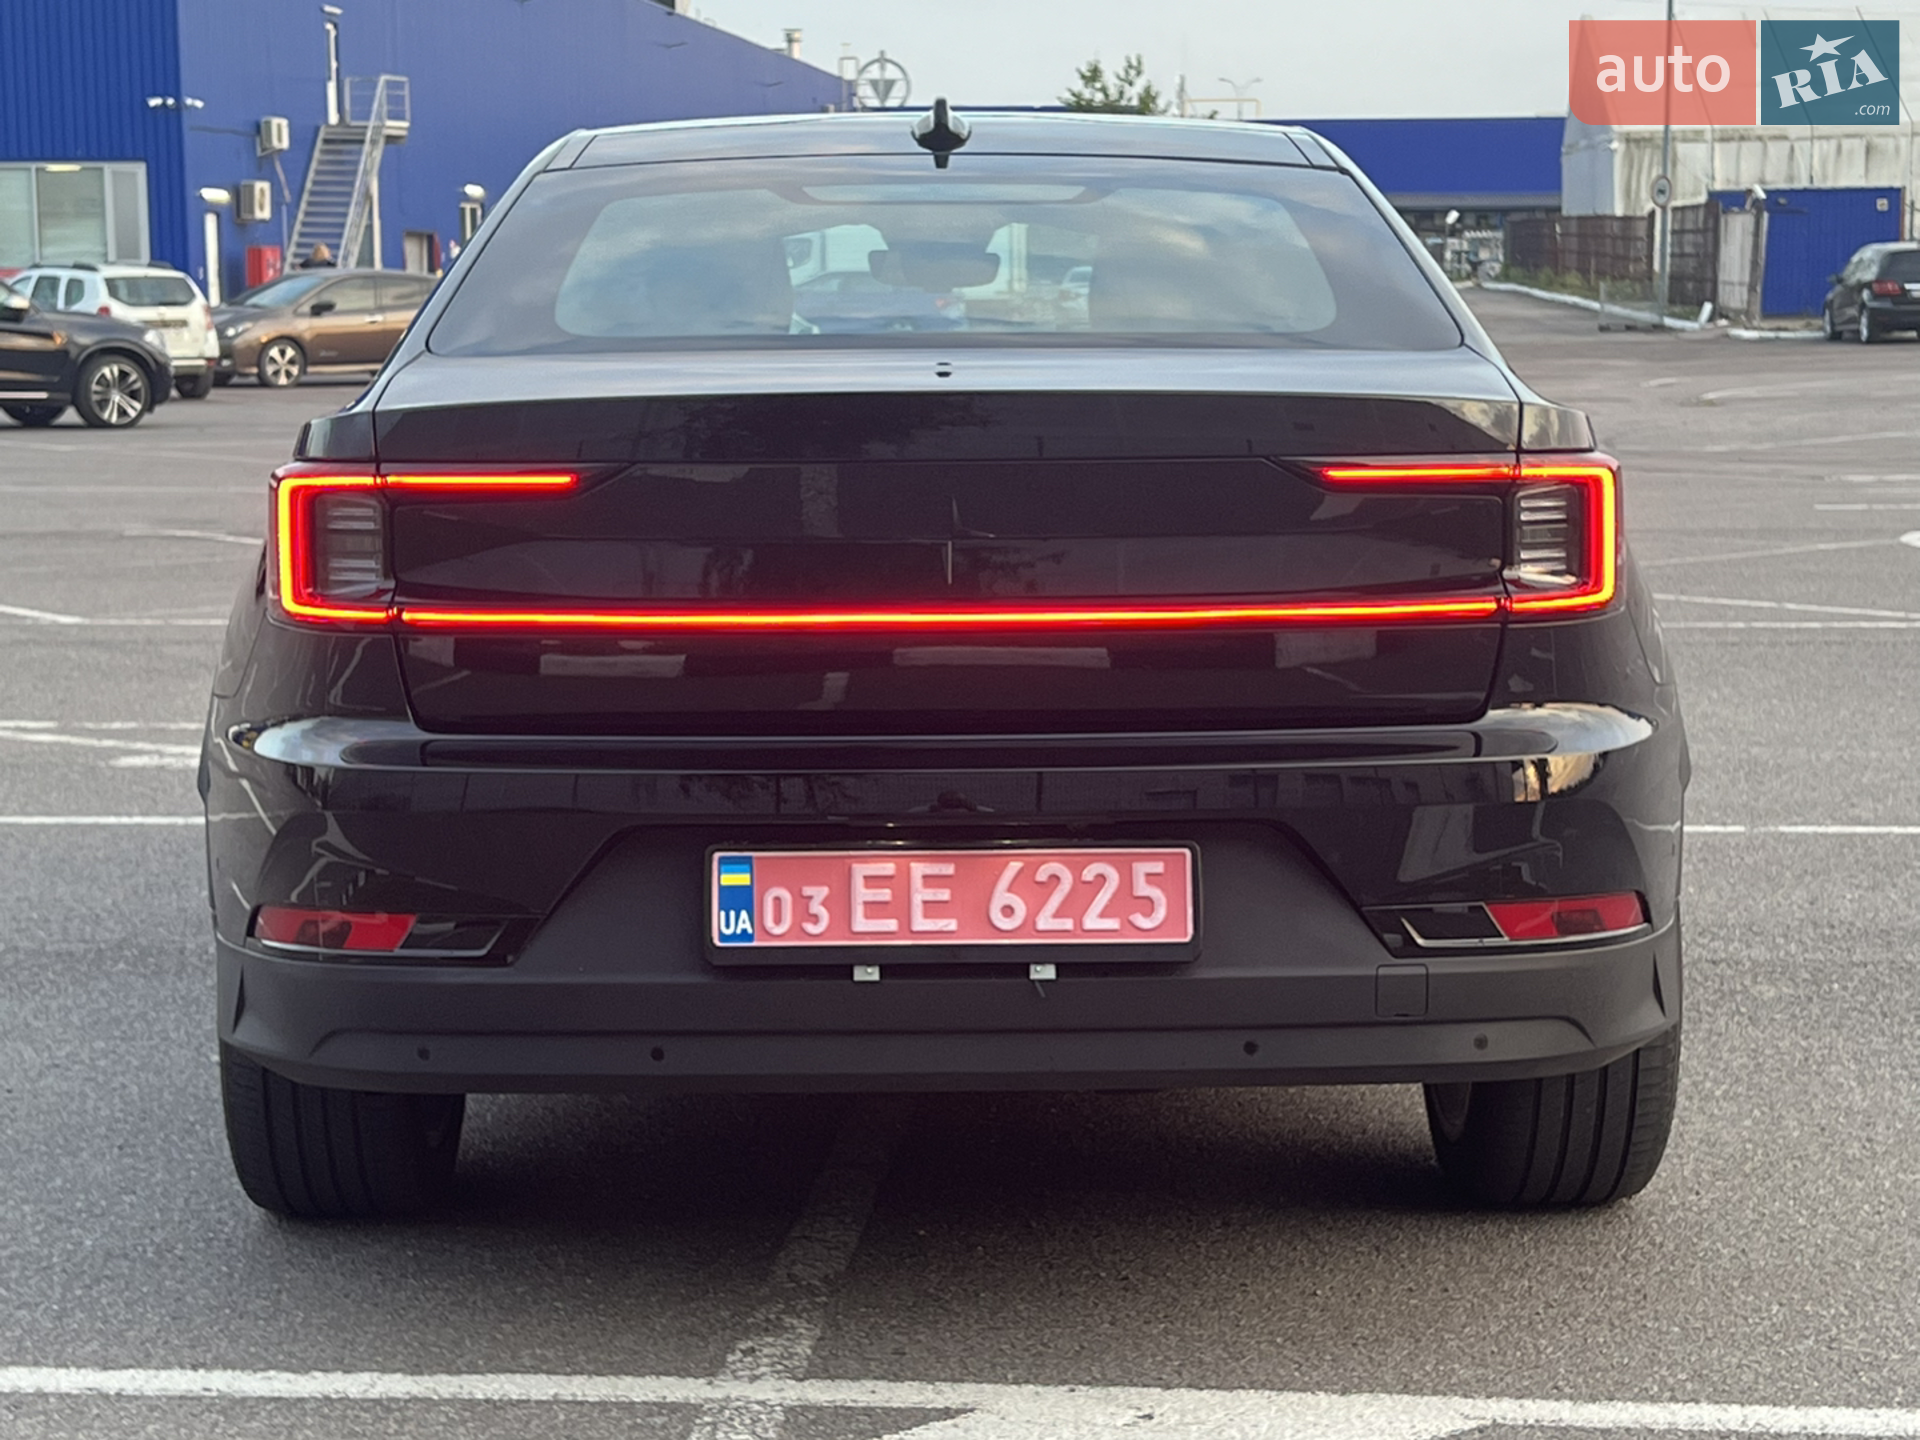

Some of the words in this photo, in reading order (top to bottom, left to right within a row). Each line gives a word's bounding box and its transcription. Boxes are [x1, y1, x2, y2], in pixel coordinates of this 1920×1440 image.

[720, 910, 753, 935] UA
[762, 886, 829, 936] 03
[850, 862, 958, 933] EE
[988, 861, 1169, 931] 6225
